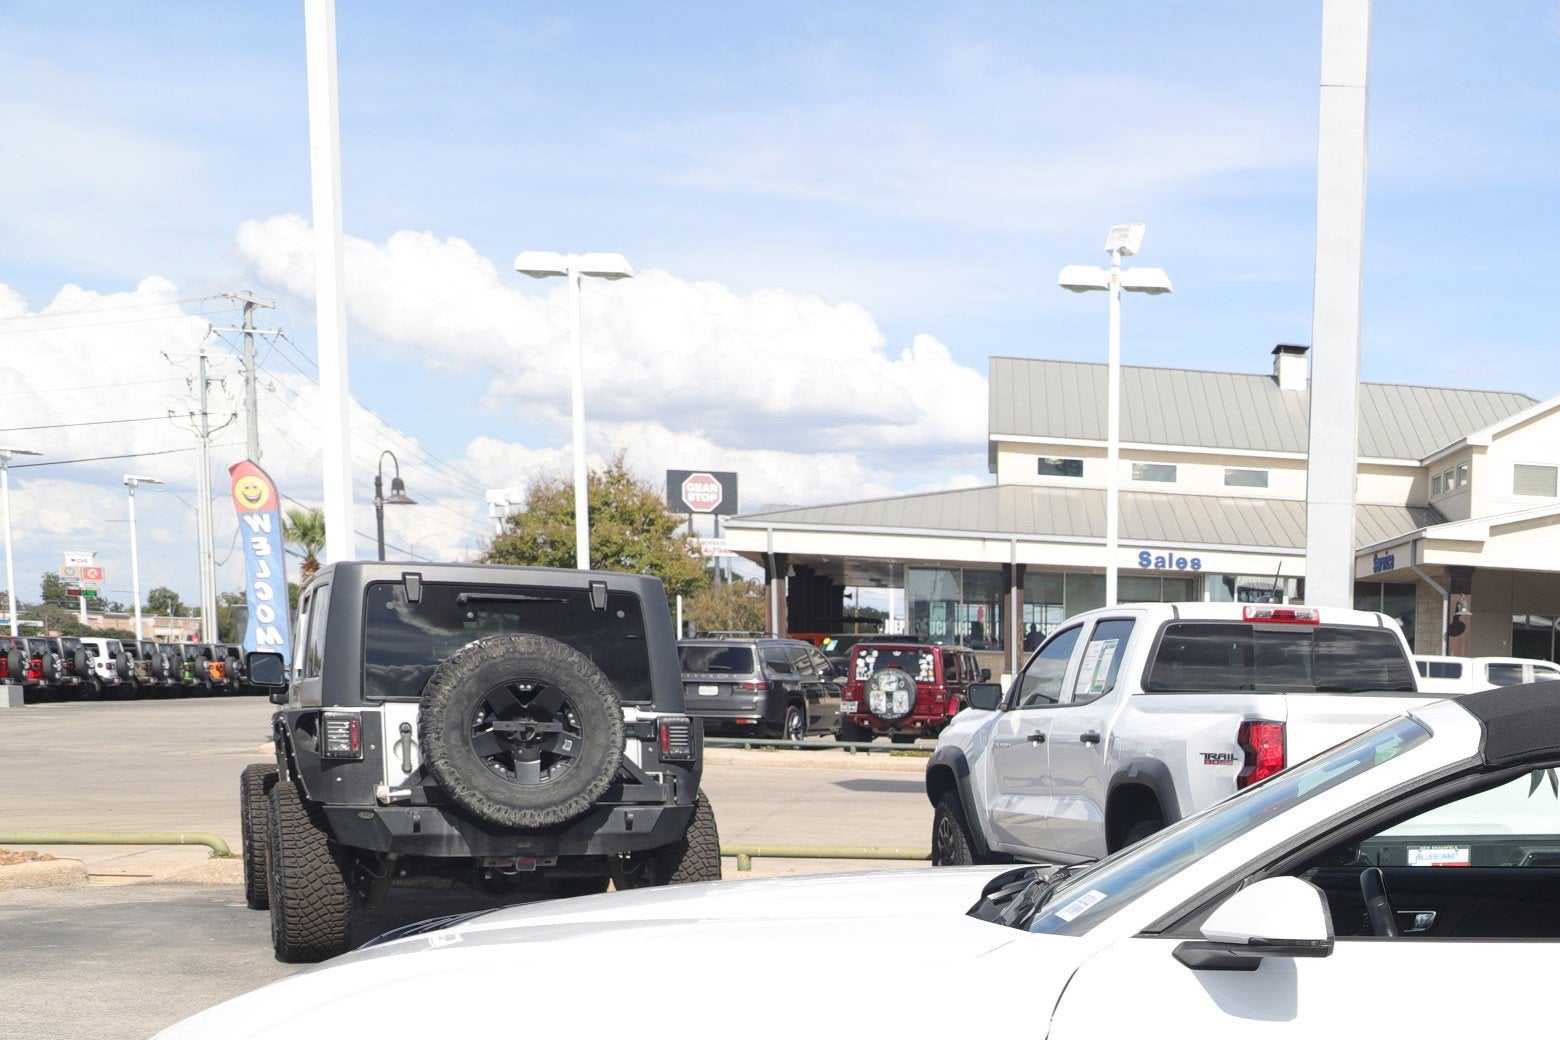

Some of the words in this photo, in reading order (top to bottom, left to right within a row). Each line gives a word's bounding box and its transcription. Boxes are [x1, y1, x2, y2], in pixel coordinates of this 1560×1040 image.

[686, 483, 718, 493] GEAR
[687, 492, 718, 502] STOP
[1138, 550, 1202, 570] Sales
[1199, 753, 1239, 761] TRAIL
